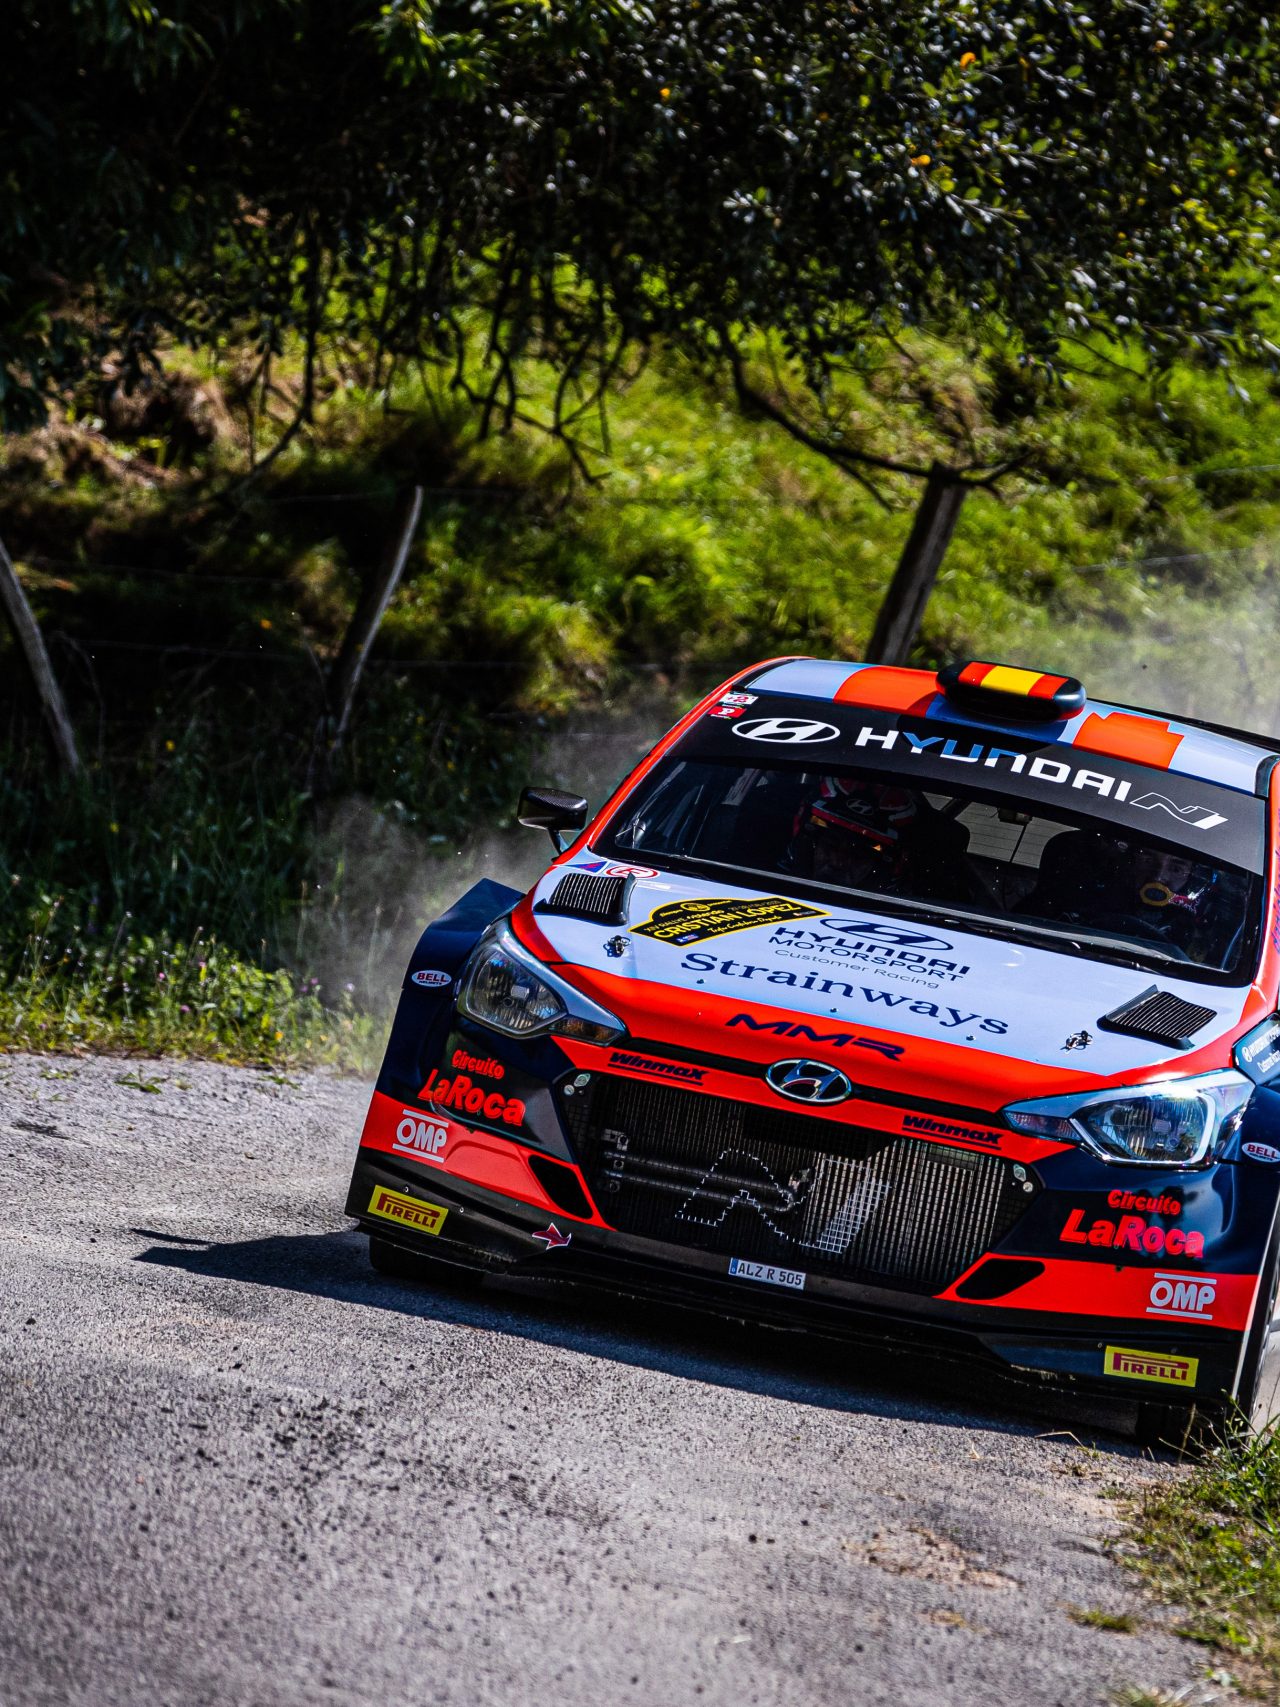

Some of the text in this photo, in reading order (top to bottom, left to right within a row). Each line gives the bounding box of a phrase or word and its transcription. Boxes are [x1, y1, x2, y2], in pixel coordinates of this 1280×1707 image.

[854, 726, 1132, 802] HYUNDAI
[654, 912, 742, 938] CRISTIAN
[768, 926, 971, 976] HYUNDAI
[768, 936, 963, 982] MOTORSPORT
[774, 949, 940, 989] Customer Racing
[417, 972, 449, 983] BELL
[681, 953, 1009, 1035] Strainways
[725, 1014, 906, 1061] MMR
[451, 1049, 505, 1080] Circuito
[417, 1068, 527, 1127] LaRoca
[396, 1119, 448, 1154] OMP
[1247, 1144, 1280, 1159] BELL
[377, 1192, 441, 1230] PIRELLI
[1107, 1189, 1182, 1215] Circuito
[1059, 1209, 1205, 1258] LaRoca
[738, 1262, 803, 1286] ALZ R 505
[1150, 1280, 1216, 1312] OMP
[1113, 1352, 1190, 1380] PIRELLI
